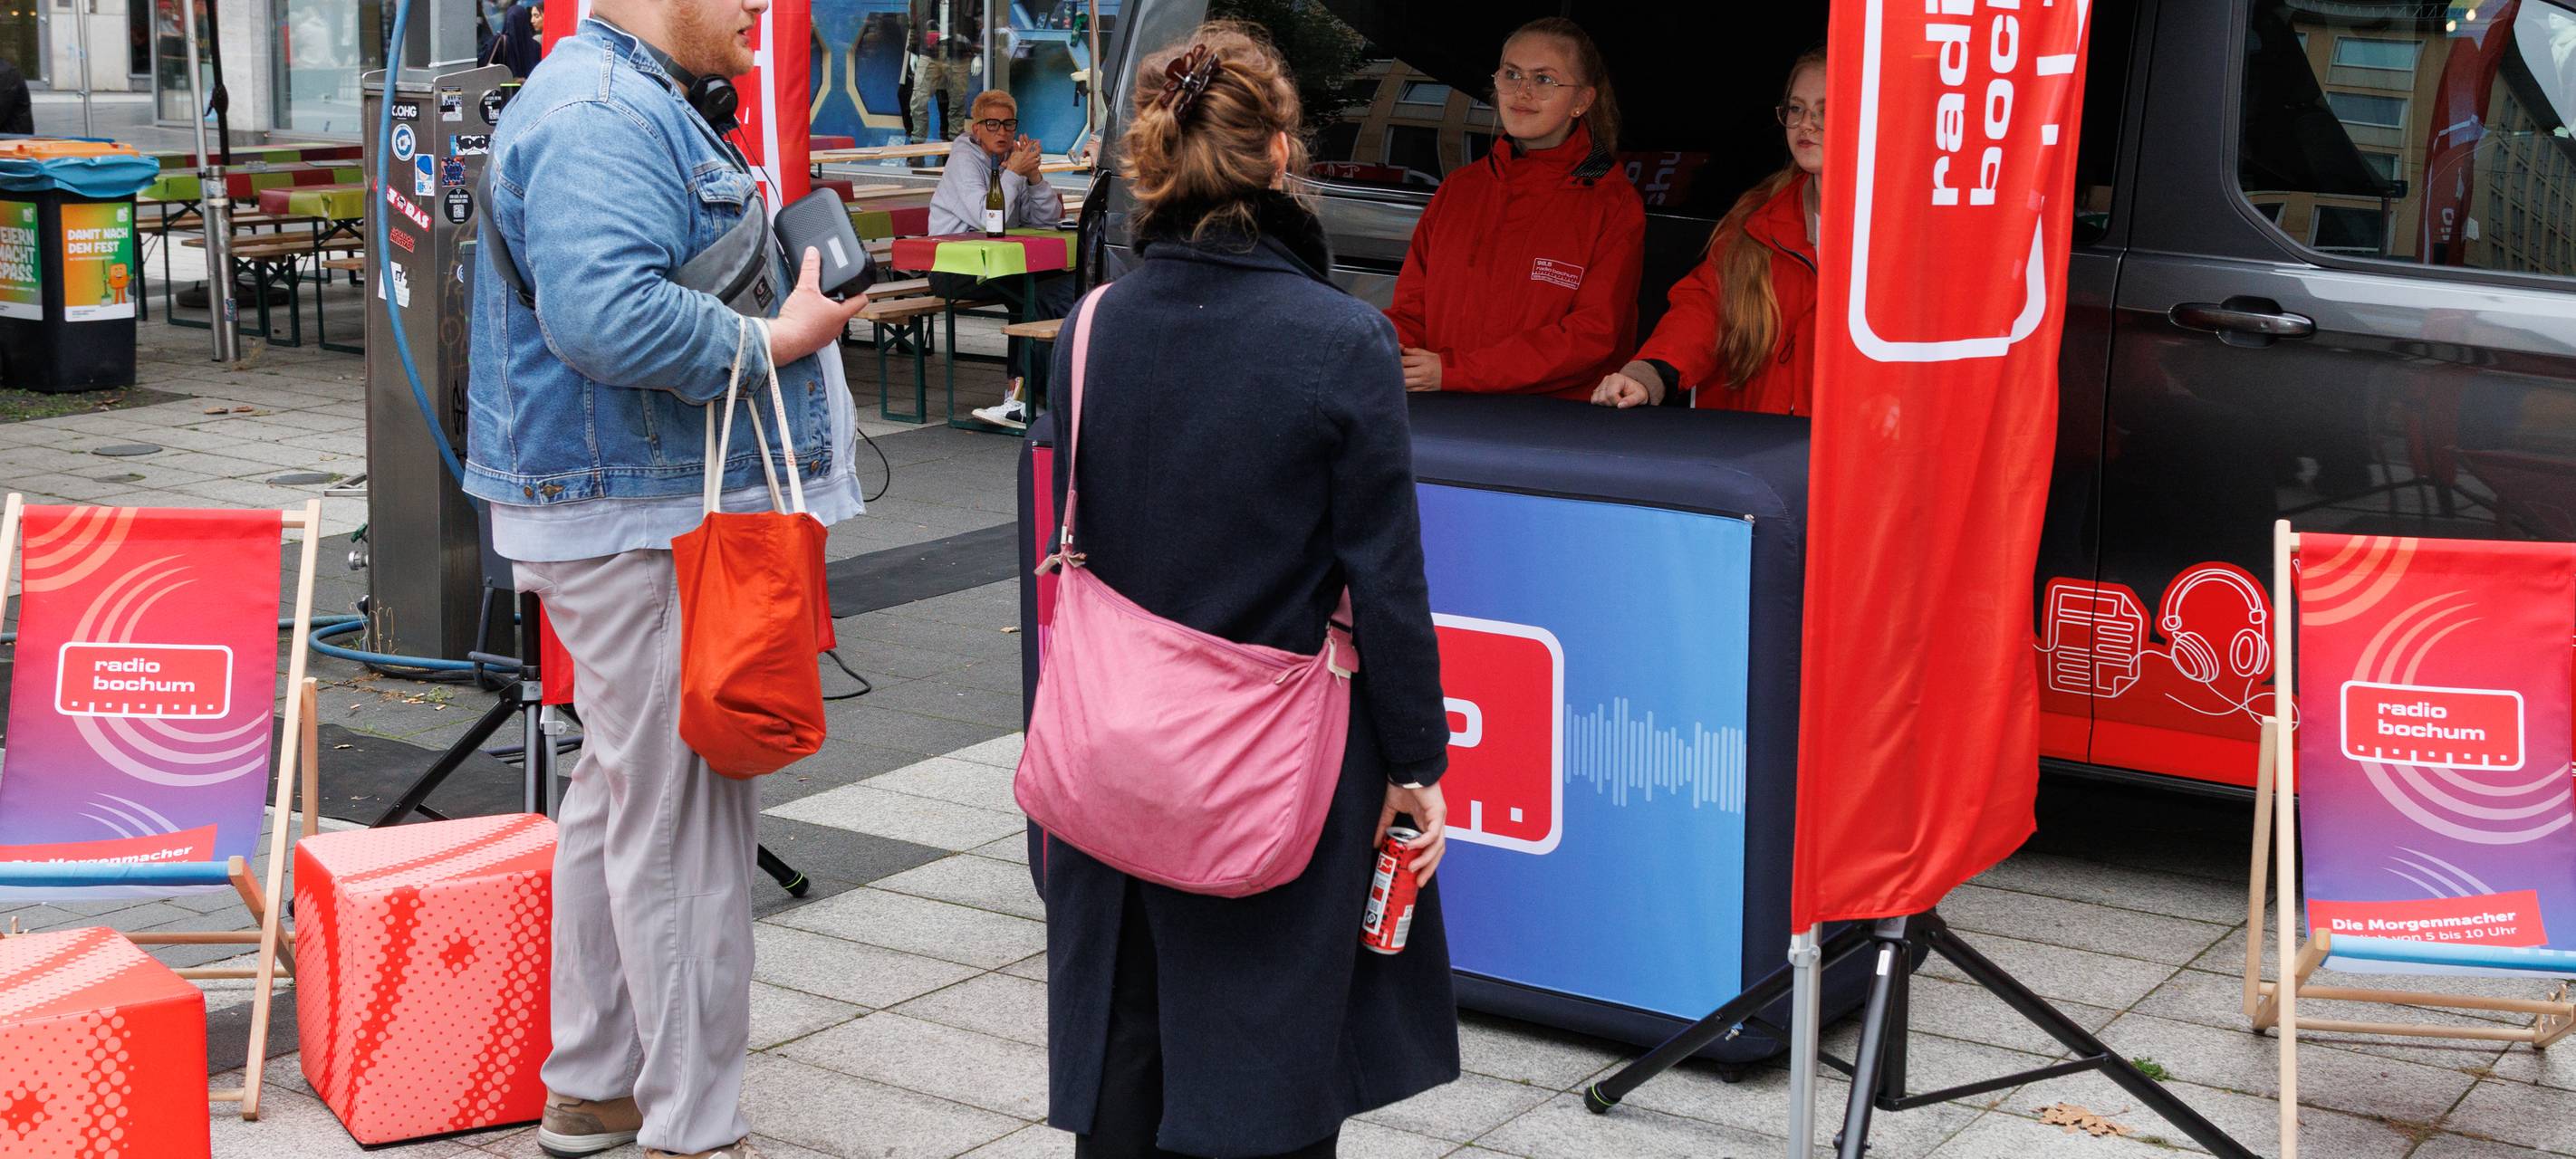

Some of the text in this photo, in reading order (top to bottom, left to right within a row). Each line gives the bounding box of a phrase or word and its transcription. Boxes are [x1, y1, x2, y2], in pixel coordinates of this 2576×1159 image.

[1969, 0, 2021, 206] boc
[67, 227, 129, 240] DAMIT NACH
[93, 241, 120, 253] FEST
[0, 262, 36, 283] PASS.
[1552, 268, 1579, 280] bochum
[94, 657, 161, 673] radio
[92, 675, 195, 693] bochum
[2378, 702, 2447, 719] radio
[2378, 719, 2485, 741] bochum
[2331, 912, 2516, 932] Die Morgenmacher
[2425, 932, 2436, 941] 5
[2439, 931, 2461, 941] bis
[2465, 929, 2484, 939] 10
[2487, 925, 2517, 936] Uhr
